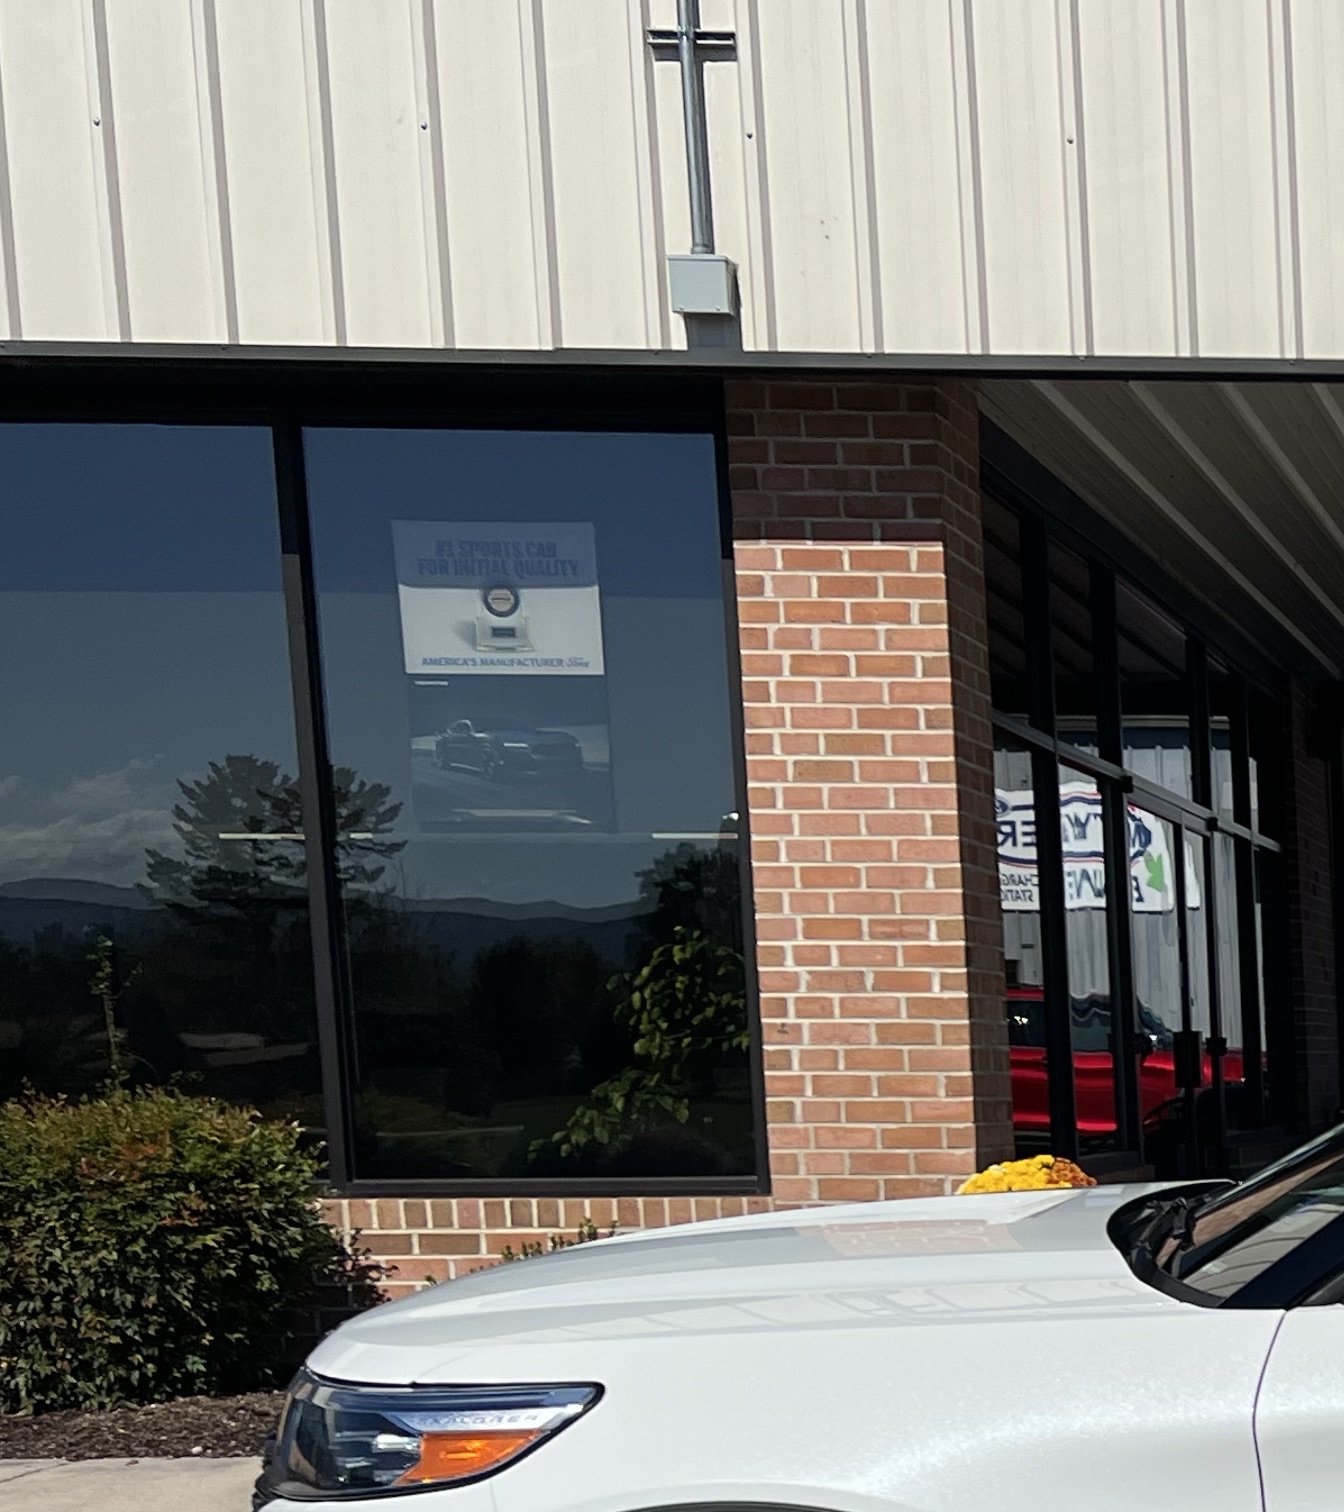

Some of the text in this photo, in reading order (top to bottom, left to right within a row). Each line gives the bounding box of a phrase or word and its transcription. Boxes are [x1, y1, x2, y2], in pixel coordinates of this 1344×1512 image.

[459, 540, 525, 559] SPORTS
[417, 558, 578, 579] FOR INITIAL QUALITY
[422, 657, 477, 667] AMERICA'S
[480, 657, 564, 668] MANUFACTURER
